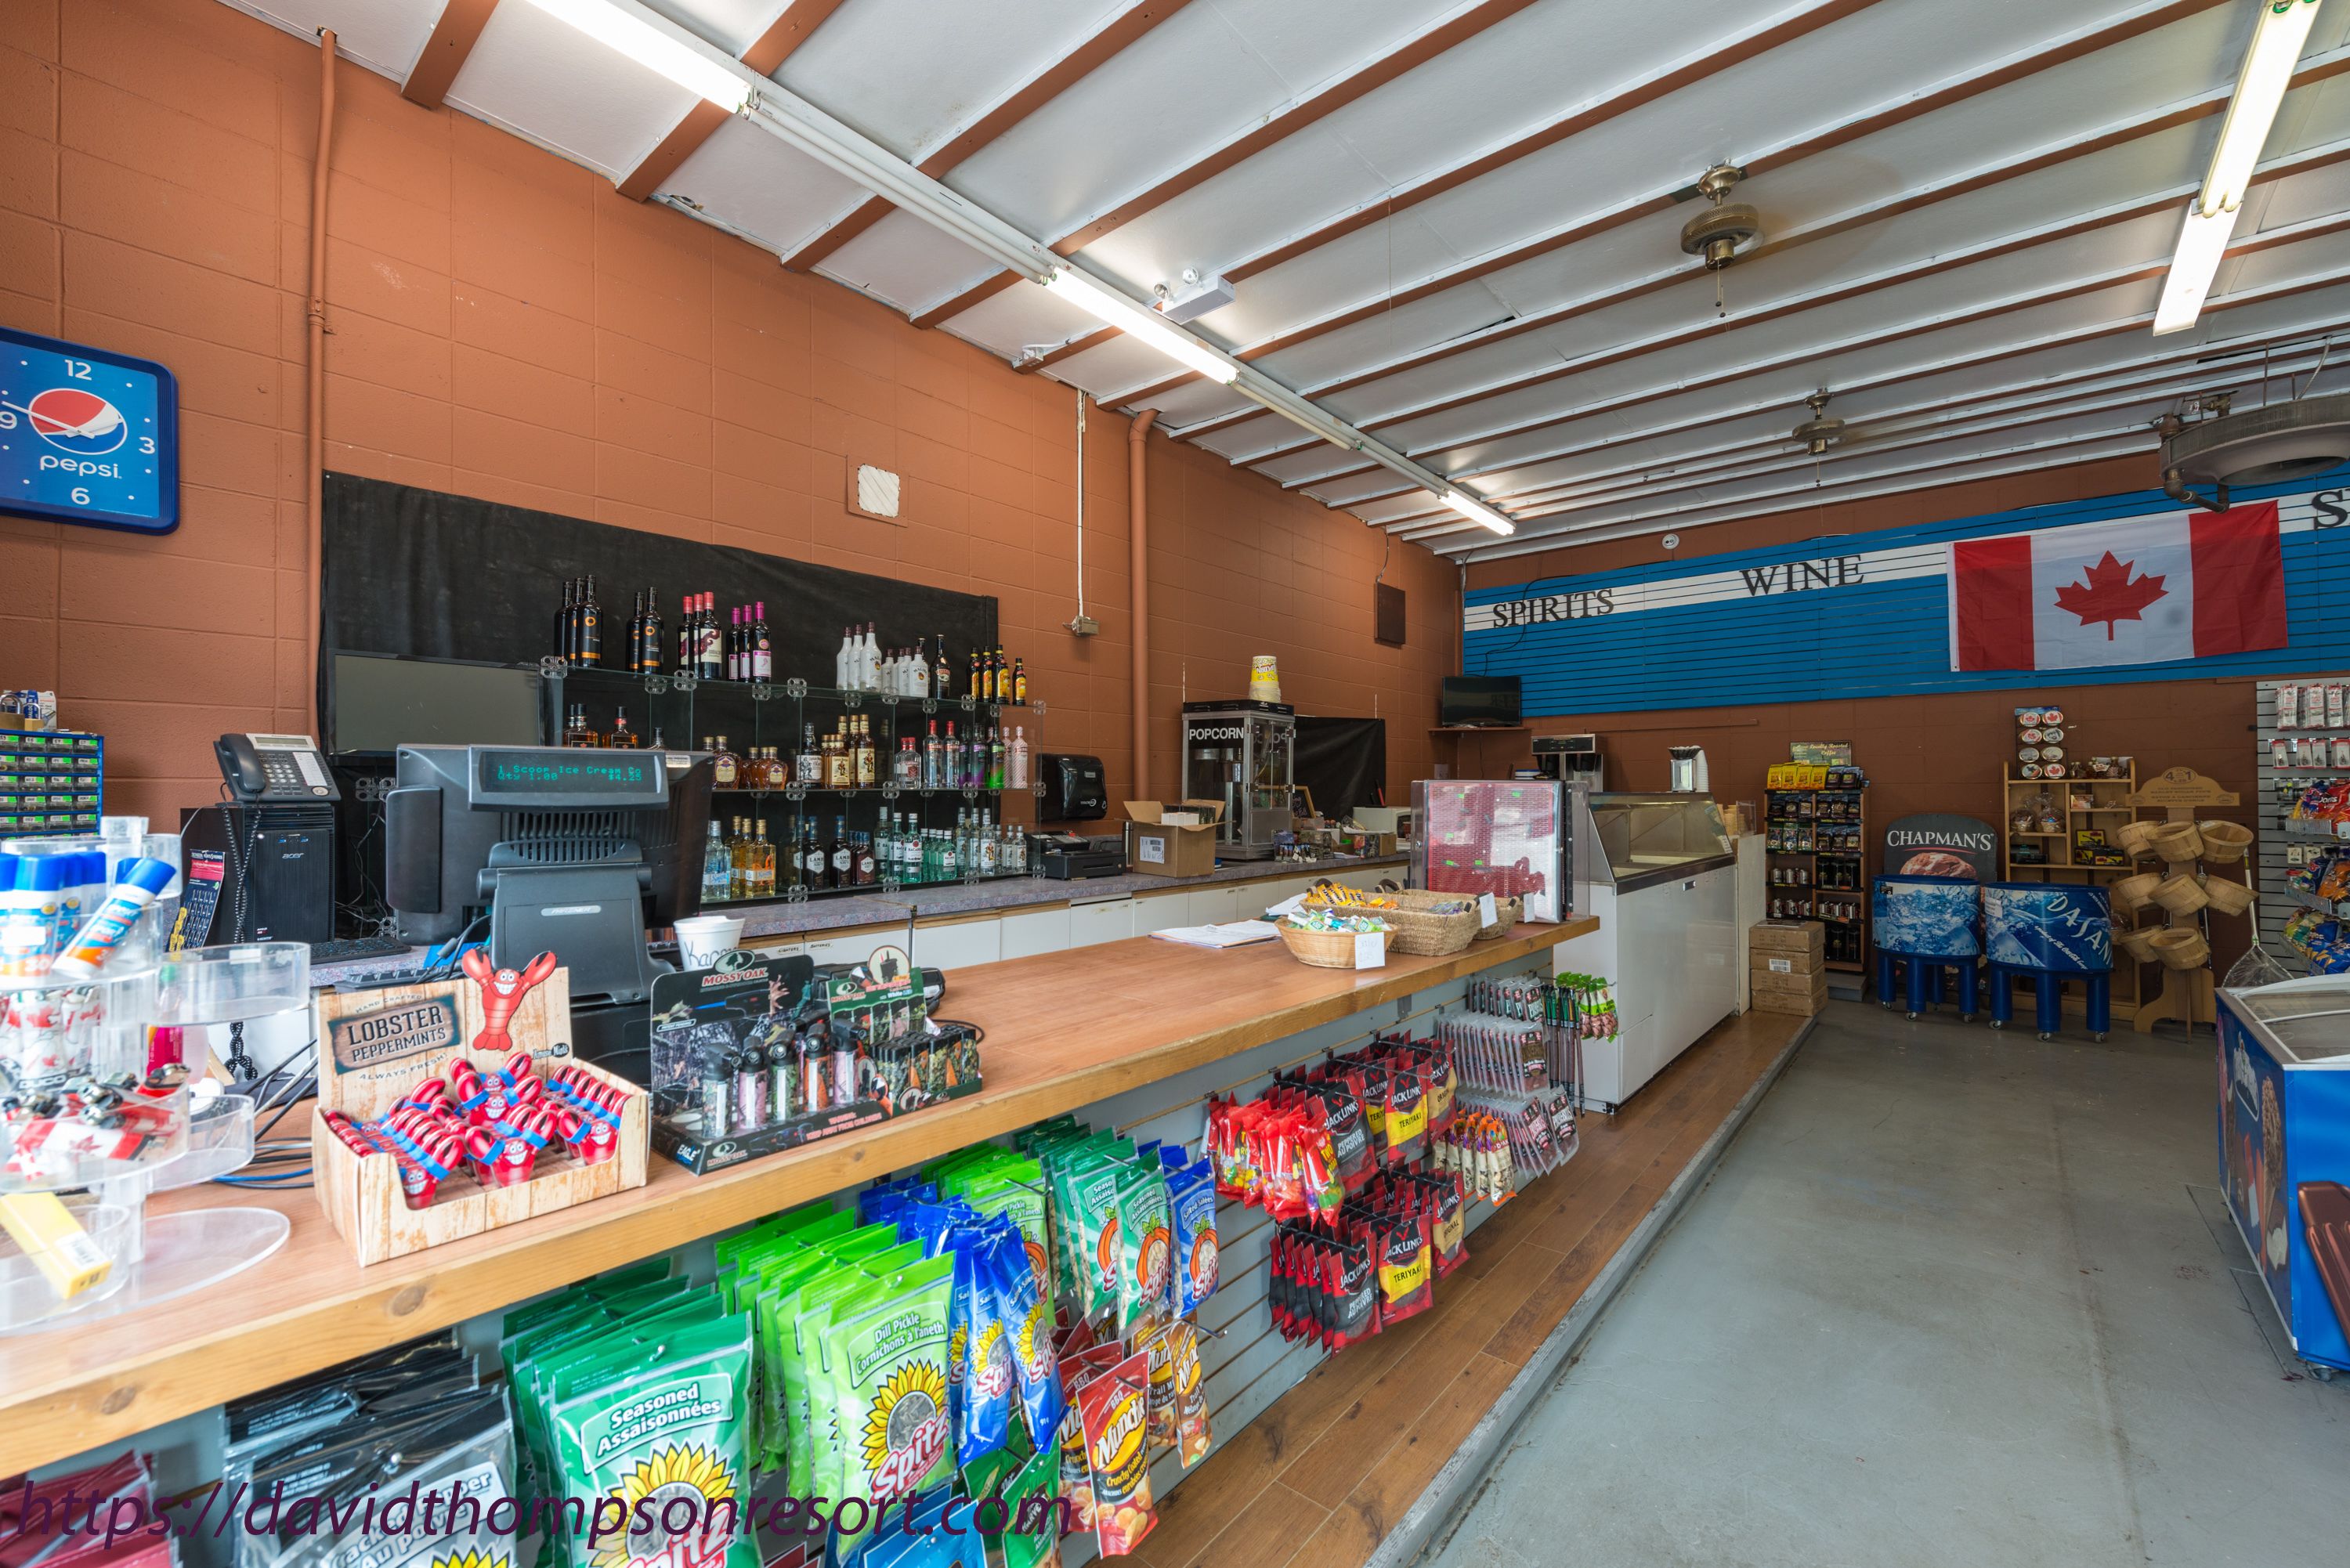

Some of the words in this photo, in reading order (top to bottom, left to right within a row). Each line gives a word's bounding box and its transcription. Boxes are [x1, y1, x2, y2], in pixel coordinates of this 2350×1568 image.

[64, 359, 92, 381] 12
[0, 411, 17, 429] 9
[139, 436, 155, 454] 3
[40, 455, 118, 479] pepsi
[71, 487, 90, 505] 6
[1739, 554, 1864, 597] WINE
[1493, 588, 1614, 629] SPIRITS
[1188, 727, 1244, 741] POPCORN
[587, 766, 621, 775] Cream
[1886, 830, 1992, 851] CHAPMAN'S
[702, 971, 742, 986] MOSSY
[743, 967, 765, 979] OAK
[355, 999, 382, 1013] HAND
[382, 994, 422, 1006] CRAFTED
[348, 1005, 443, 1046] LOBSTER
[352, 1028, 446, 1063] PEPPERMINTS
[359, 1067, 407, 1081] ALWAYS
[409, 1053, 449, 1072] FRESH!
[1362, 1086, 1377, 1097] JACK
[1391, 1092, 1408, 1106] JACK
[1325, 1111, 1342, 1129] JACK
[1399, 1112, 1422, 1129] TERIYAKI
[1337, 1129, 1363, 1150] PEPPERED
[1337, 1149, 1346, 1158] AU
[1344, 1135, 1366, 1154] POIVRE
[1131, 1195, 1162, 1220] Assaisonnées
[1133, 1188, 1155, 1209] Seasoned
[1384, 1245, 1404, 1261] JACK
[1340, 1270, 1357, 1288] JACK
[1393, 1266, 1422, 1283] TERIYAKI
[874, 1324, 891, 1343] Dill
[893, 1313, 920, 1331] Pickle
[856, 1335, 906, 1375] Cornichons
[907, 1331, 913, 1342] à
[914, 1323, 945, 1339] l'aneth
[1073, 1373, 1090, 1390] BBQ
[610, 1383, 700, 1429] Seasoned
[1110, 1390, 1124, 1410] BBQ
[595, 1399, 721, 1458] Assaisonnées
[870, 1407, 949, 1501] Spitz
[1106, 1469, 1129, 1487] Crunchy
[1128, 1452, 1143, 1476] Coated
